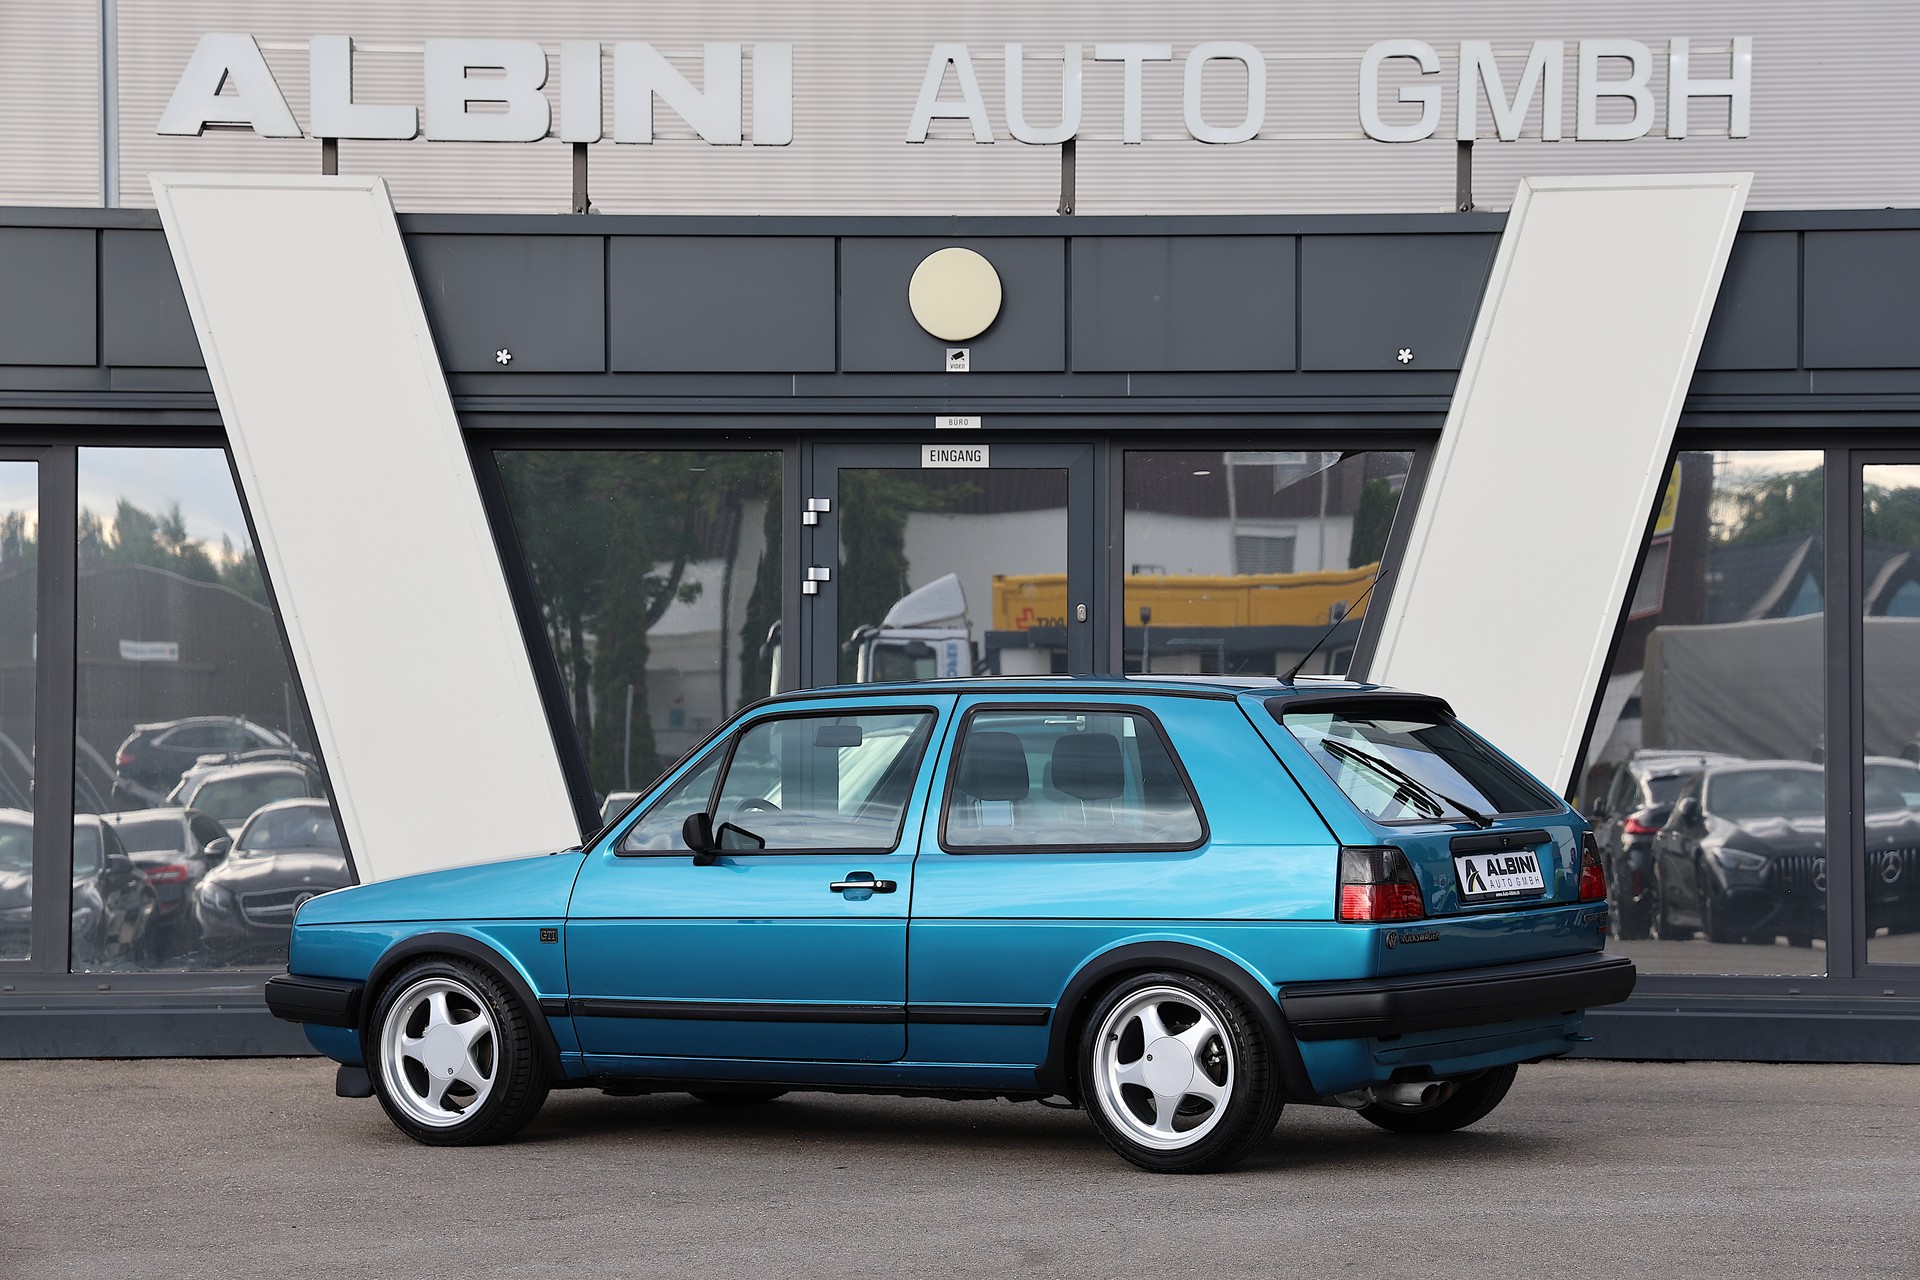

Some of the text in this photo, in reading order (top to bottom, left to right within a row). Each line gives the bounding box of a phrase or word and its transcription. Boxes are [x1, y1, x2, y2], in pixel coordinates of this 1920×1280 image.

[156, 32, 1753, 146] ALBINI AUTO GMBH
[948, 417, 969, 426] BÜRO
[930, 450, 981, 462] EINGANG
[1487, 856, 1536, 876] ALBINI
[1490, 876, 1540, 888] AUTO GMBH
[541, 930, 556, 940] GTI
[1401, 931, 1440, 943] VOLKSWAGEN
